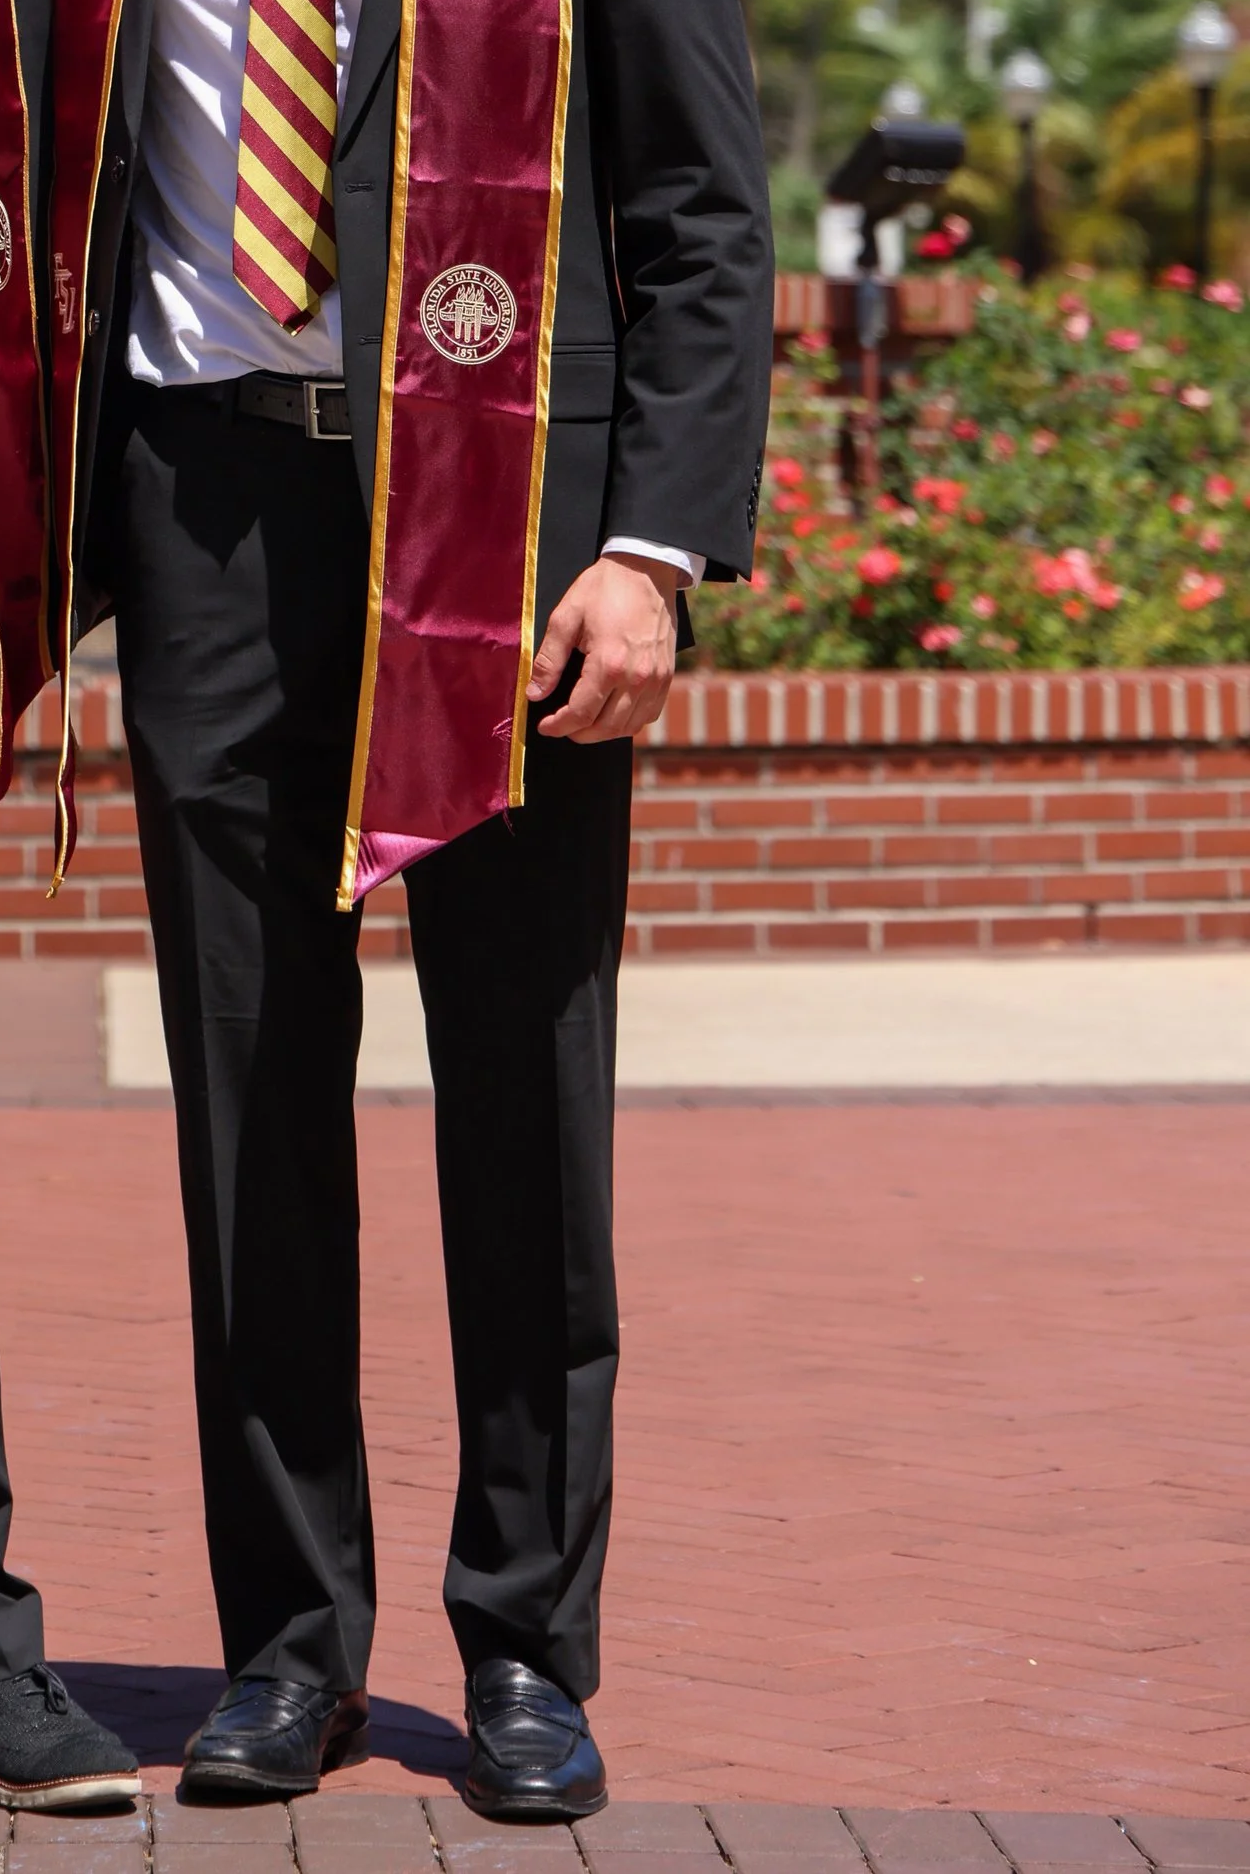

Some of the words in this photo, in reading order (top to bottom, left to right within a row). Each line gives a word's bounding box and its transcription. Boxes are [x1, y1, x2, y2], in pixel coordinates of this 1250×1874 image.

[54, 253, 75, 334] FSU
[426, 283, 447, 337] FLORIDA
[446, 270, 481, 285] STATE
[483, 275, 511, 344] UNIVERSITY
[455, 346, 478, 358] 1851
